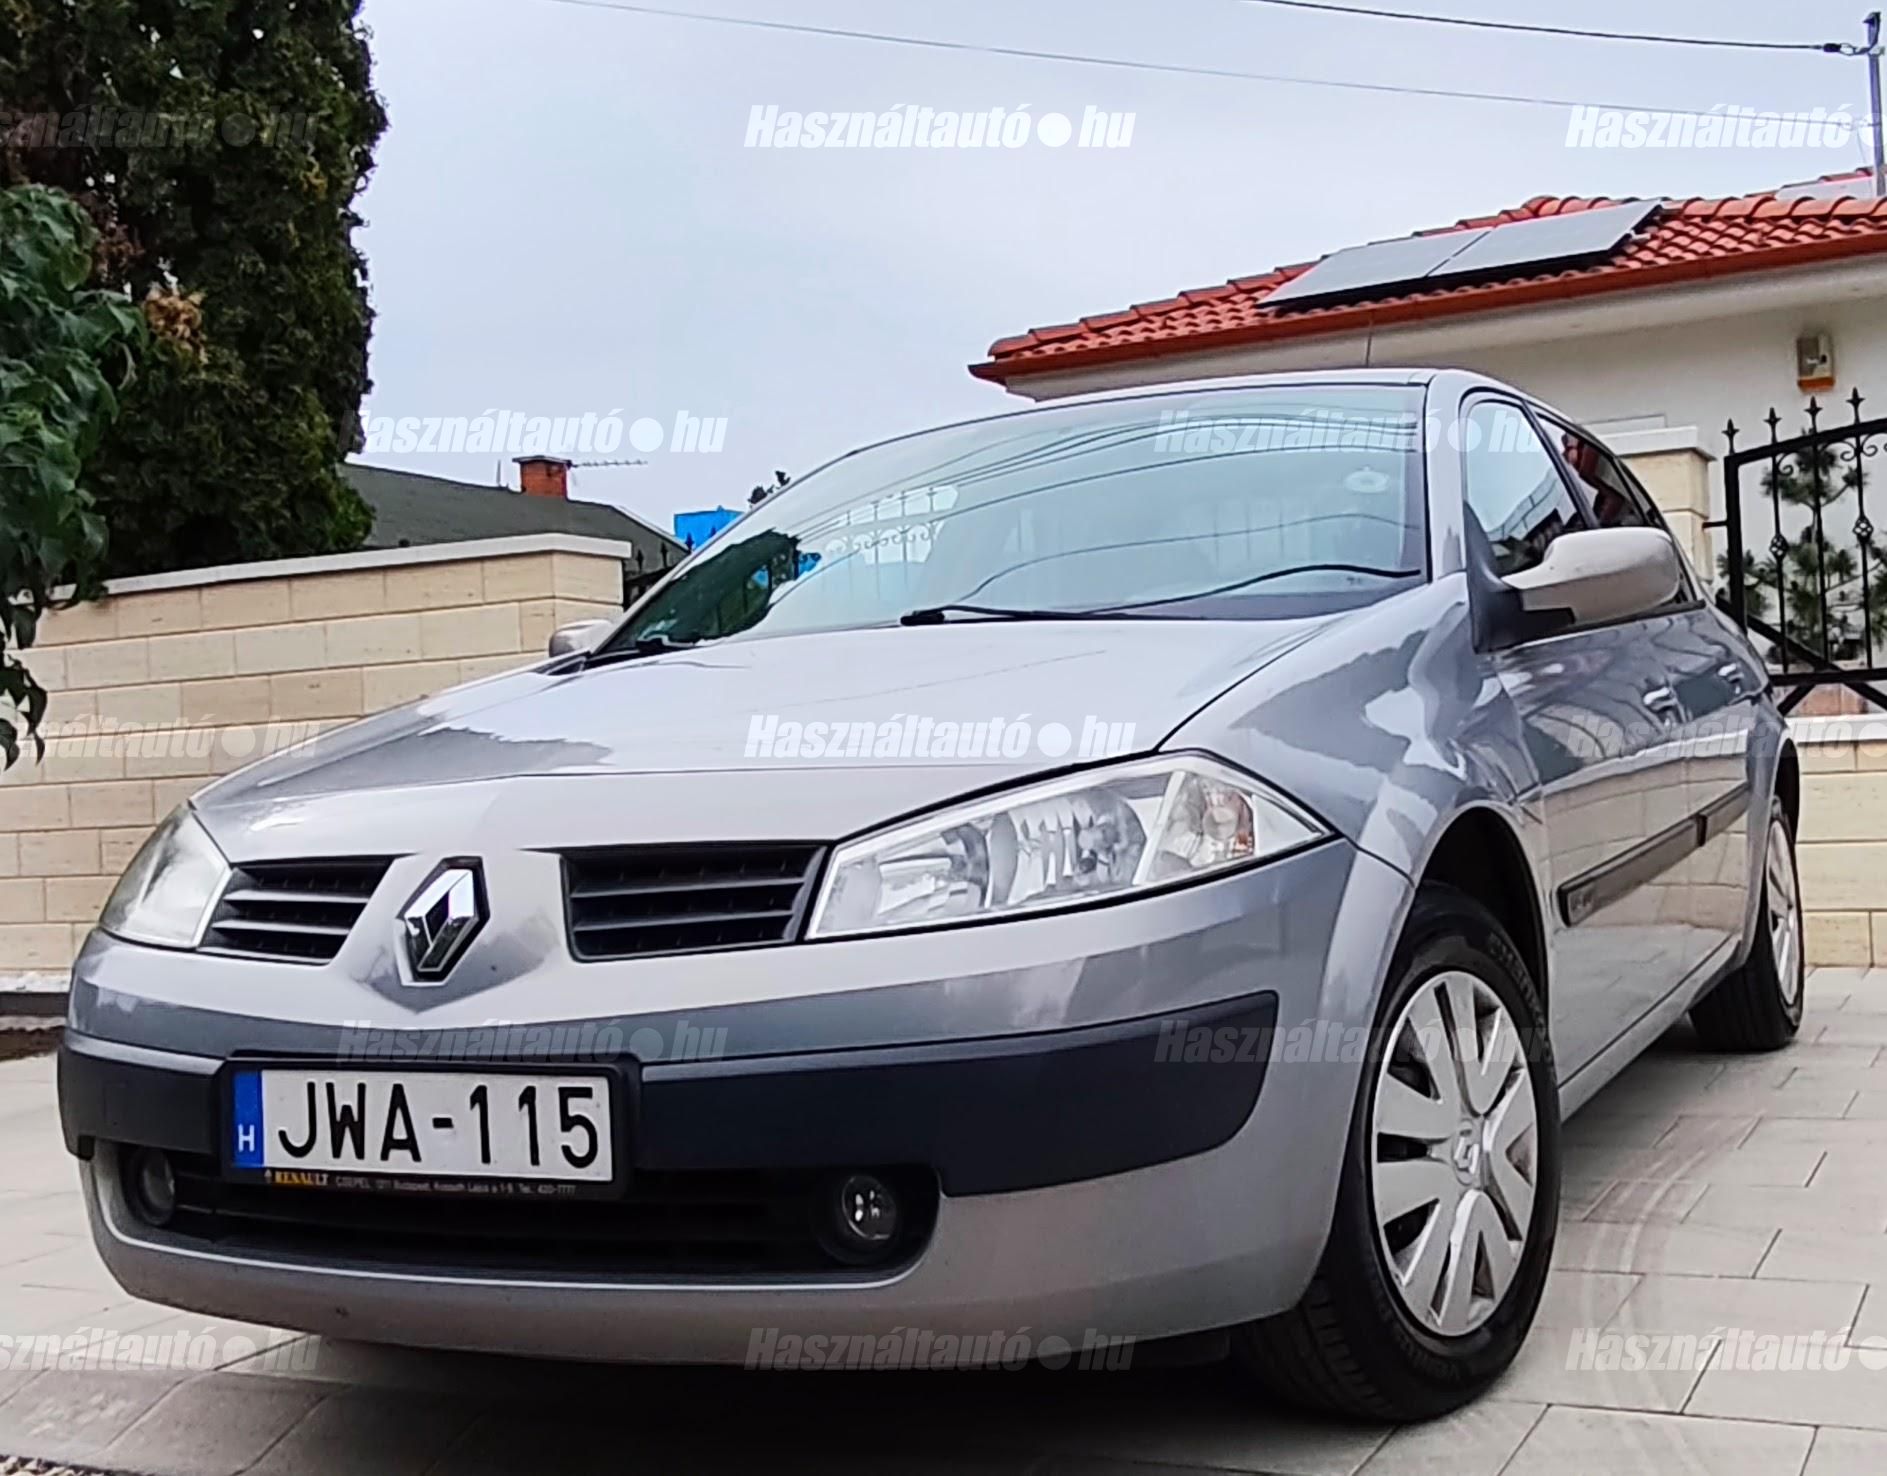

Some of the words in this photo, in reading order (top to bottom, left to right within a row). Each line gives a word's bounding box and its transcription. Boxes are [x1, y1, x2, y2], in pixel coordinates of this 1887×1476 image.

[237, 1124, 255, 1152] H
[278, 1081, 599, 1169] JWA-115
[274, 1170, 330, 1187] RENAULT
